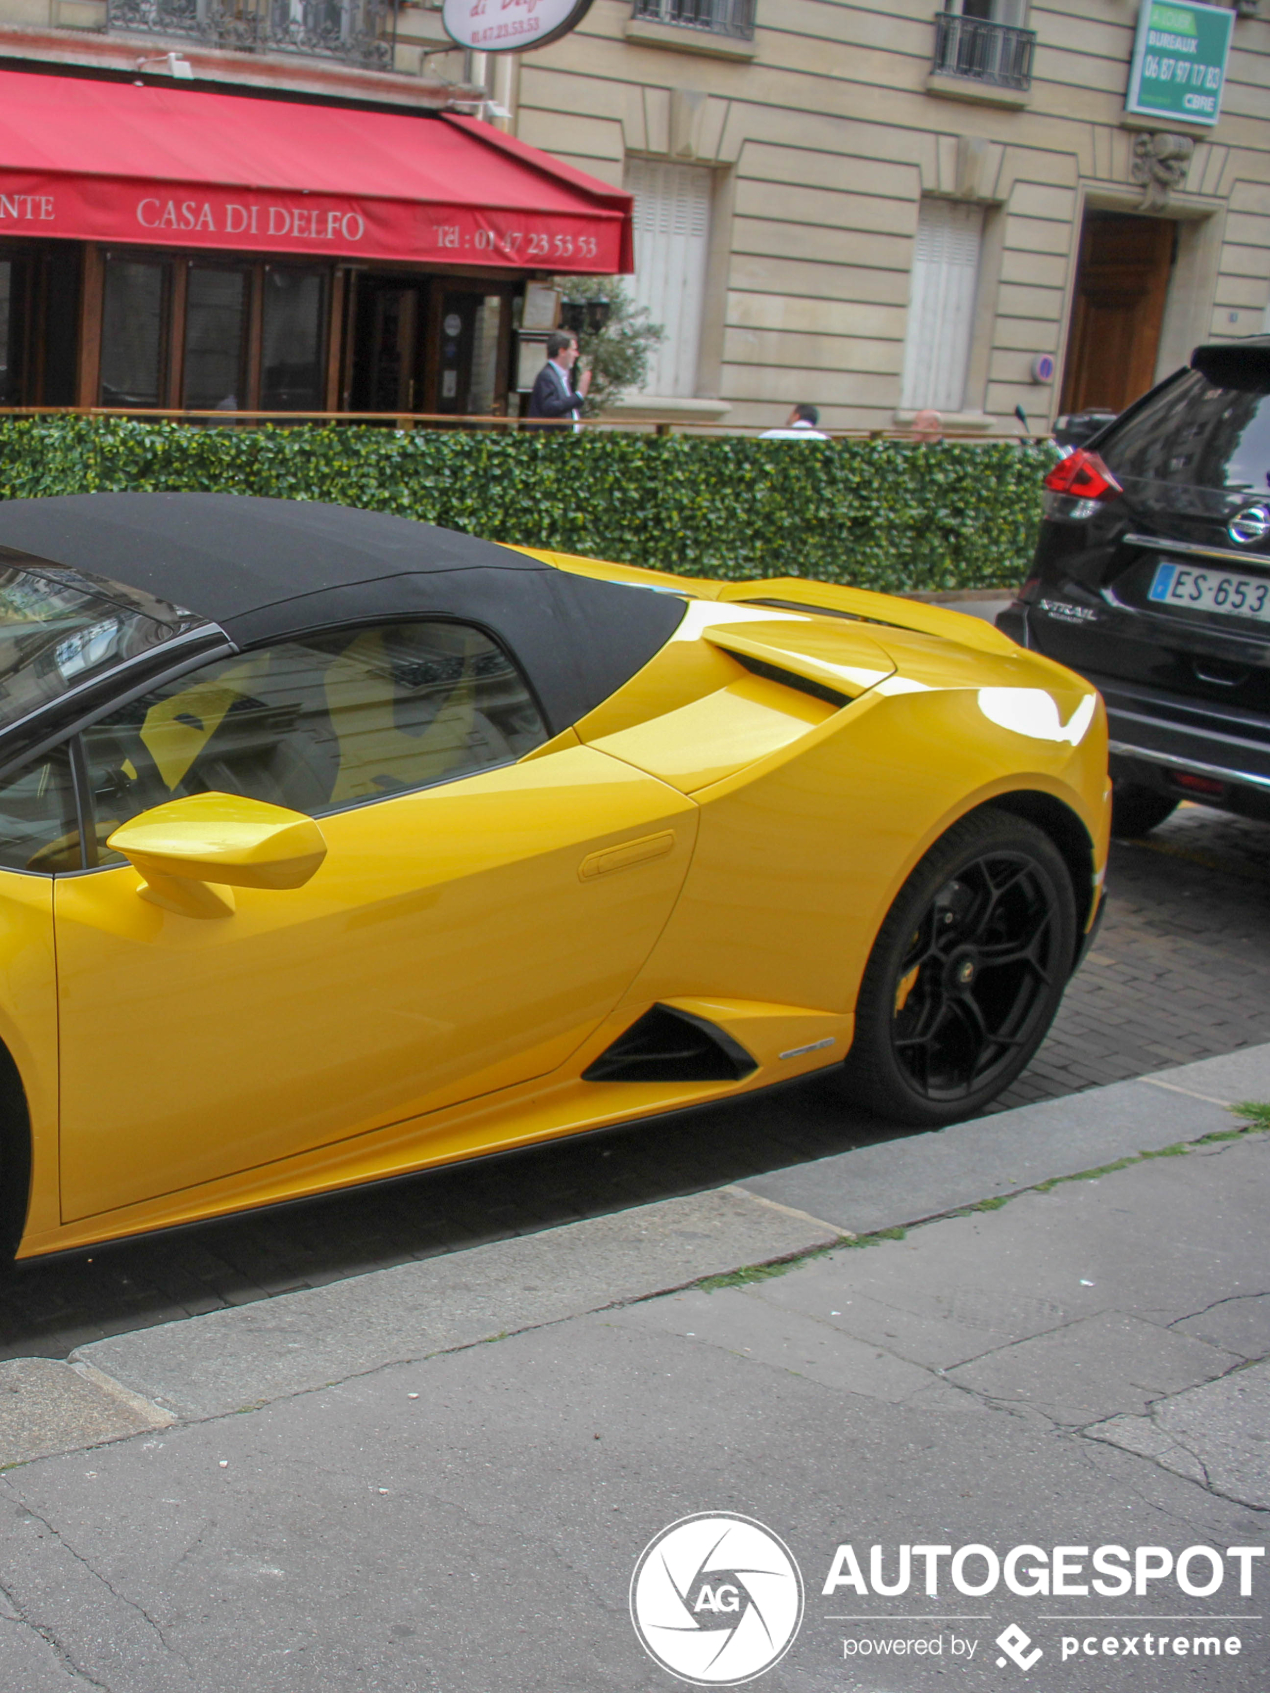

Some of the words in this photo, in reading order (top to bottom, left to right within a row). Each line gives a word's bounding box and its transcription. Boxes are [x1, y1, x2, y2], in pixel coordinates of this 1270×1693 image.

[1148, 30, 1199, 53] BUREAUX
[1145, 55, 1160, 78] 06
[1160, 58, 1176, 81] 87
[1176, 60, 1191, 83] 97
[1192, 63, 1206, 86] 17
[1206, 66, 1221, 89] 83
[1184, 93, 1216, 112] CBRE
[136, 198, 216, 231] CASA
[224, 204, 260, 234] DI
[267, 206, 365, 241] DELFO
[433, 224, 460, 248] Tél
[474, 229, 495, 250] 01
[499, 231, 523, 253] 47
[527, 233, 549, 255] 23
[553, 235, 574, 257] 53
[577, 237, 598, 258] 53
